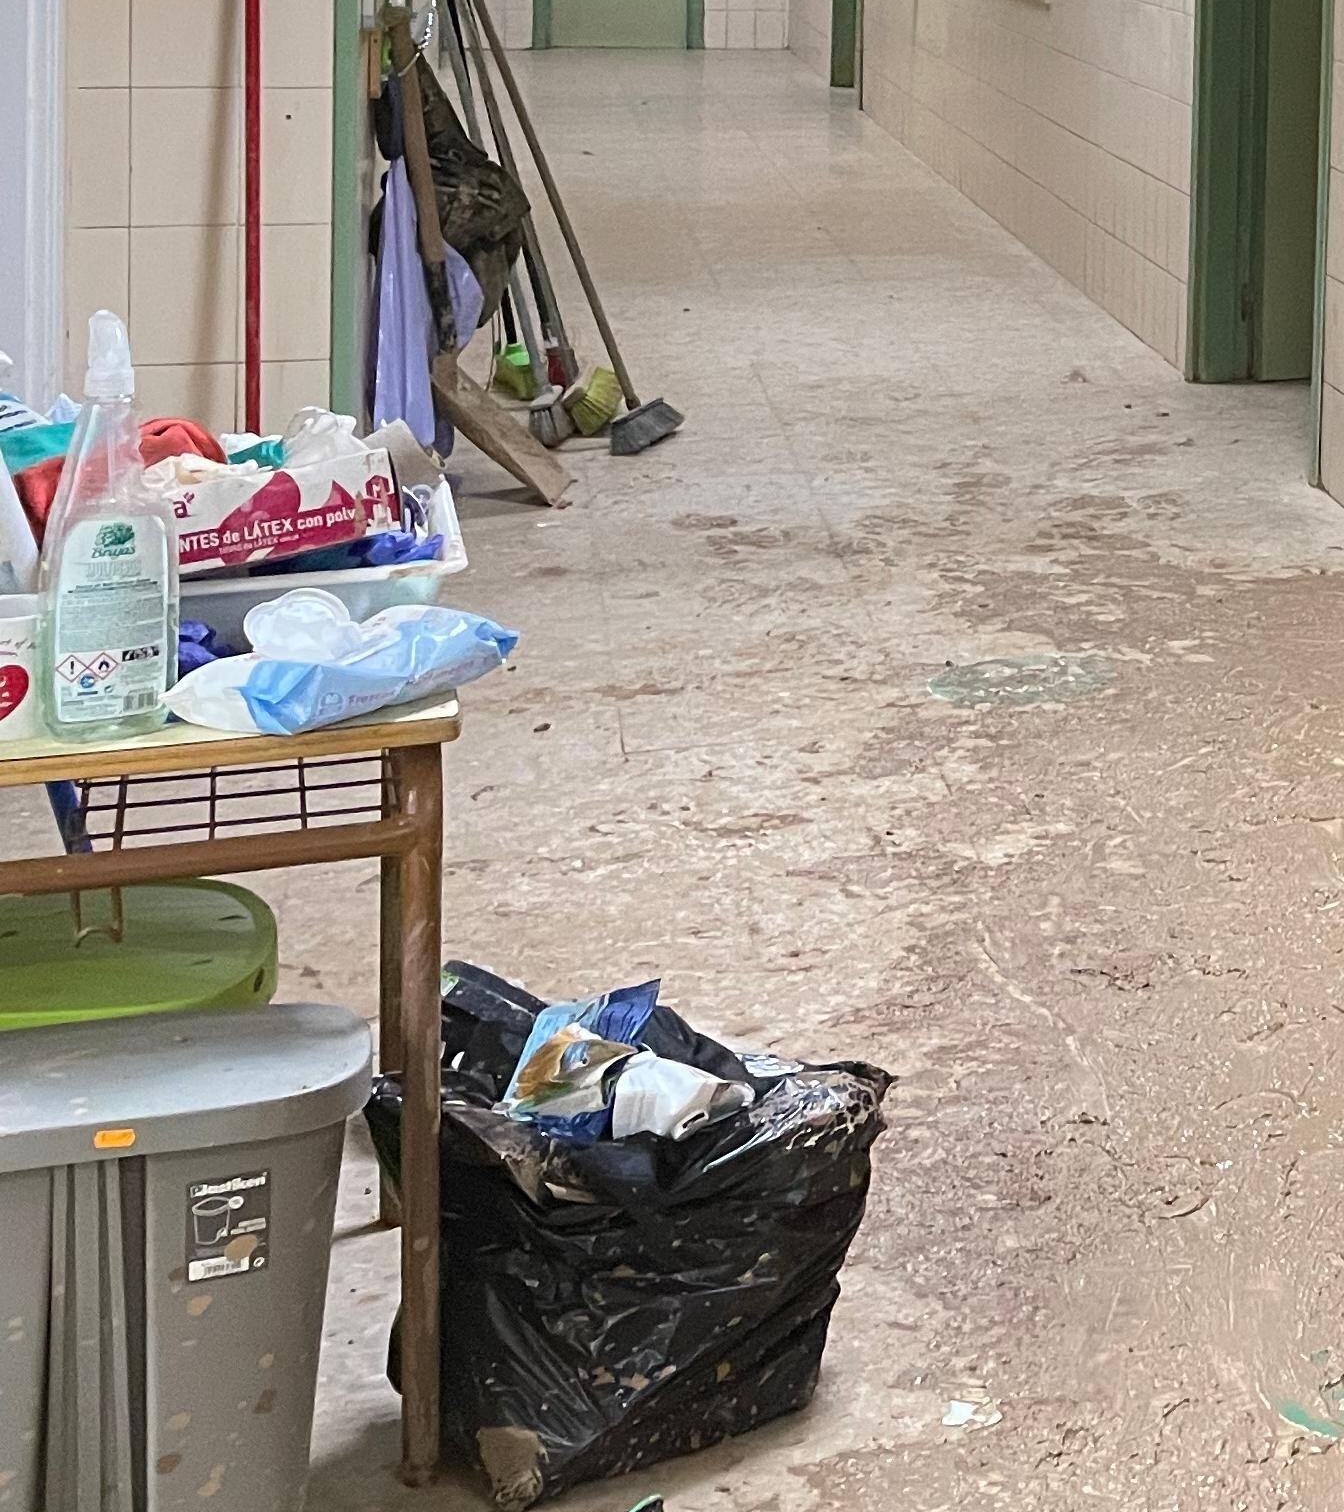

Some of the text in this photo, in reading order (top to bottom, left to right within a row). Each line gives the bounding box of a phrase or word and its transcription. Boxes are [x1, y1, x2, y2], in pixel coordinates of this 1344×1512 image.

[179, 531, 220, 554] NTES
[222, 529, 241, 544] de
[244, 518, 294, 540] LÁTEX
[297, 513, 324, 529] con
[326, 506, 356, 529] polv
